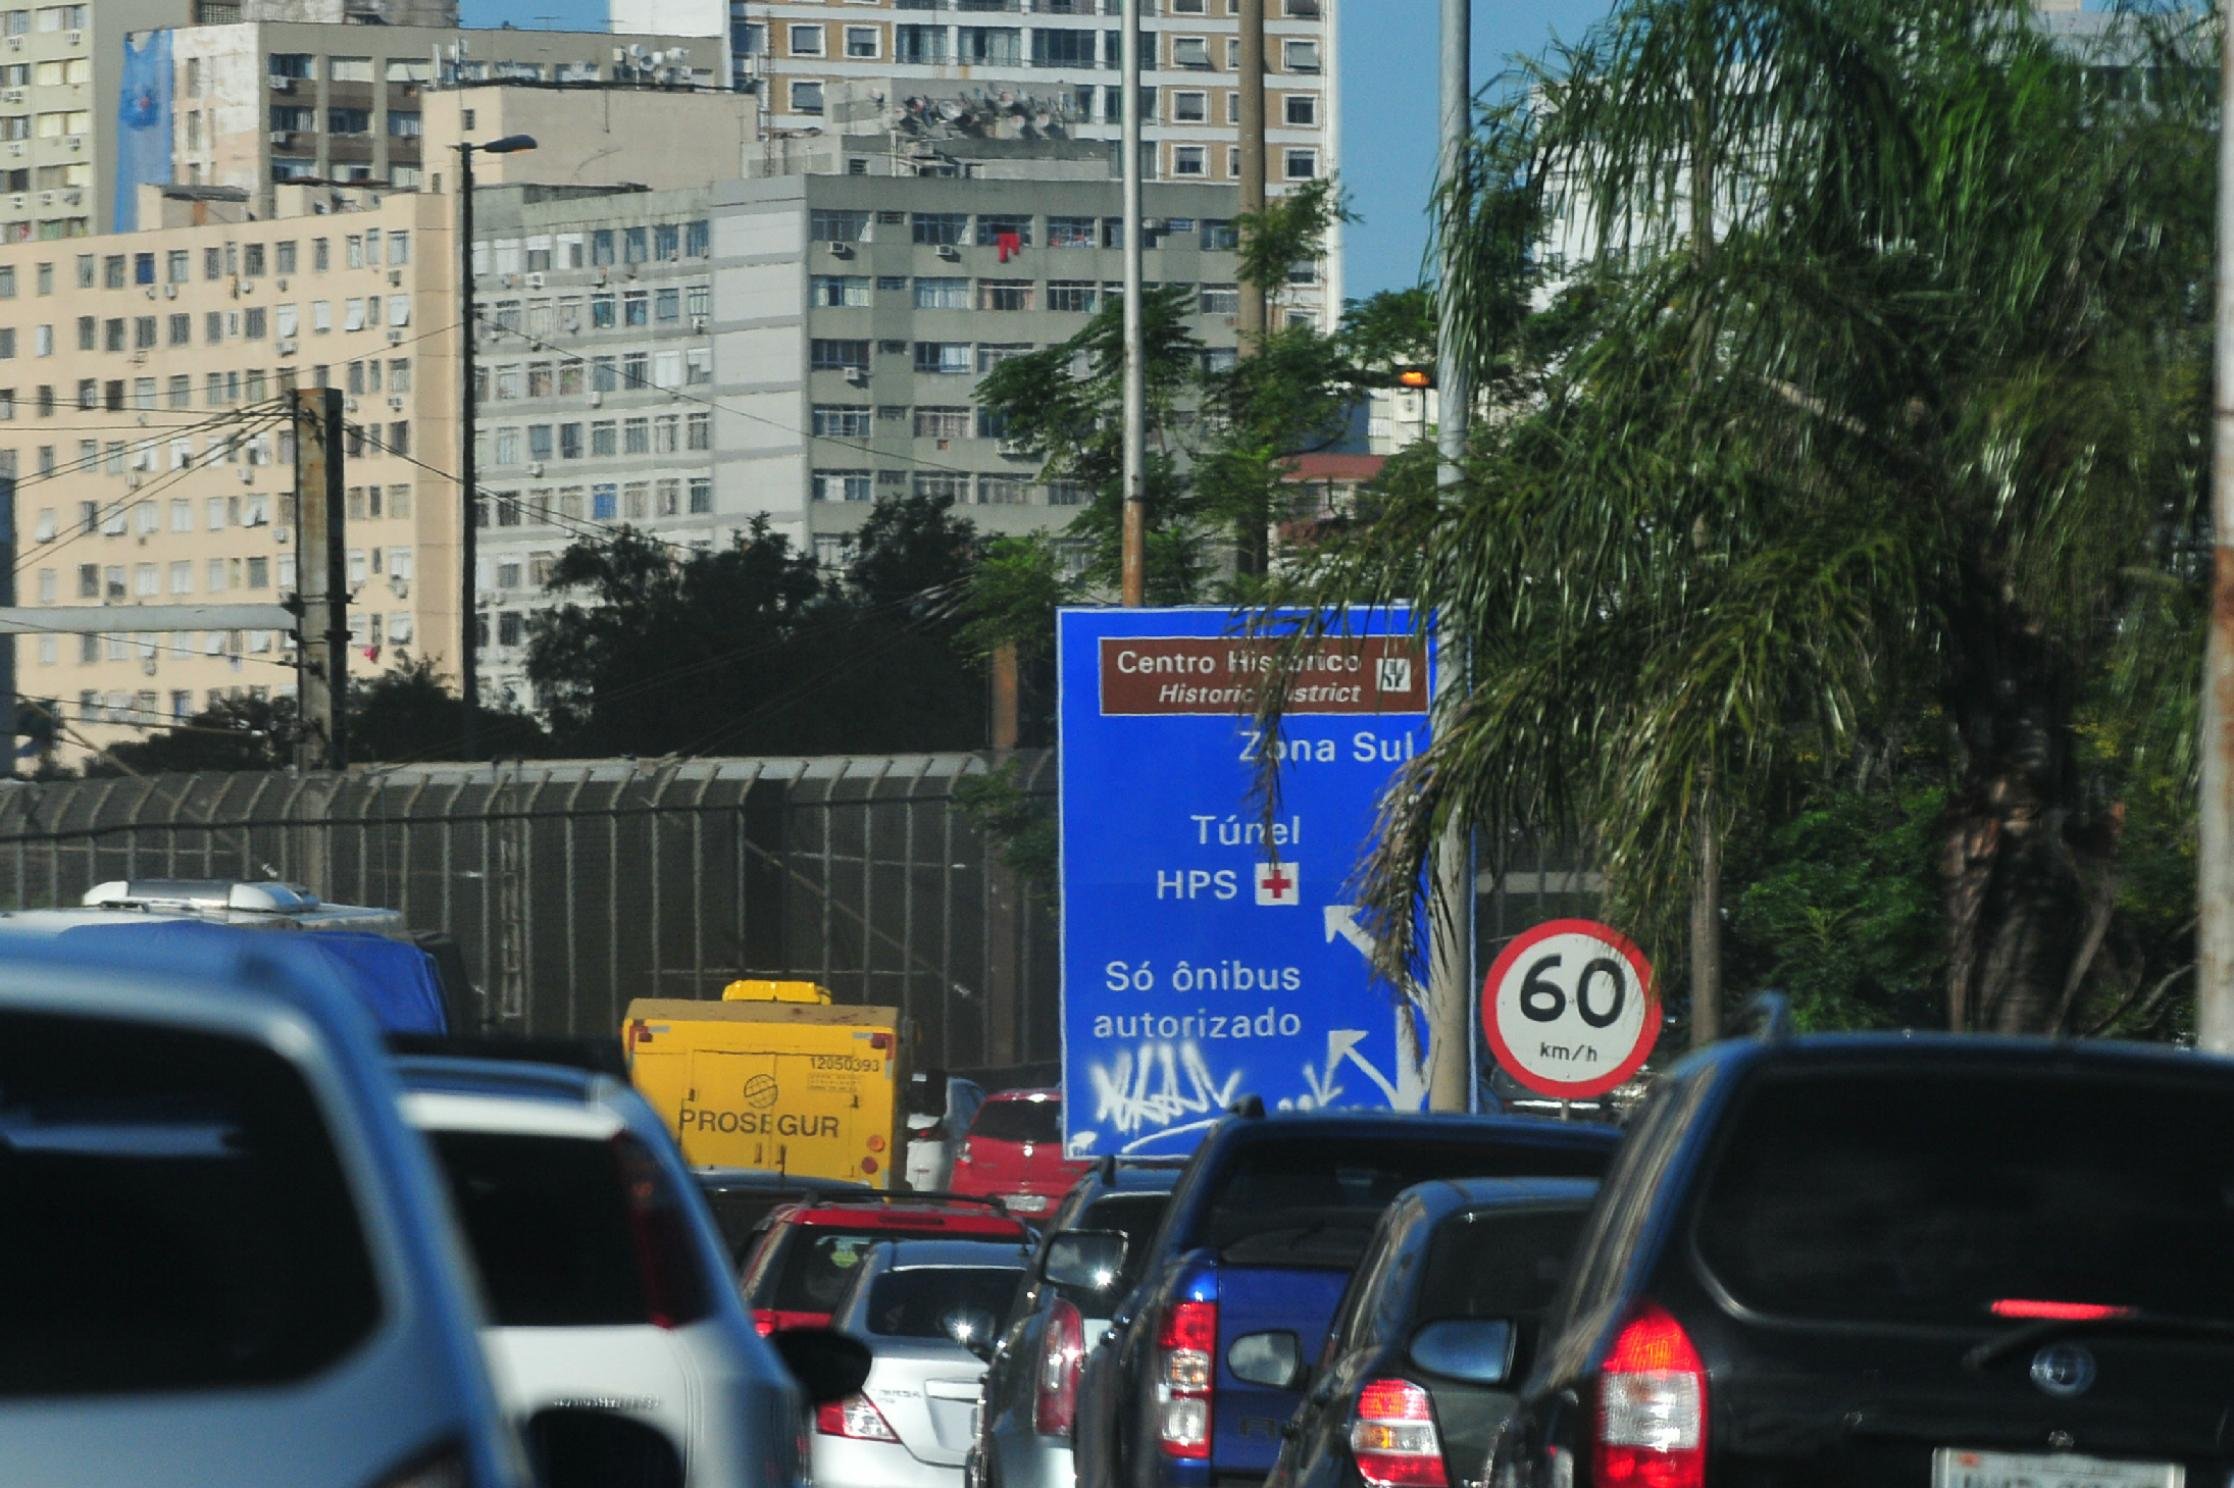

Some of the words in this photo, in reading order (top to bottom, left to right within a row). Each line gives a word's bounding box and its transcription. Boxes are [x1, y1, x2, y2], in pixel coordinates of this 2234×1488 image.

[1117, 650, 1216, 674] Centro
[1227, 650, 1362, 673] Hisrico
[1158, 683, 1256, 703] Historic
[1267, 682, 1362, 703] strict
[1239, 730, 1336, 762] Zona
[1352, 730, 1415, 762] Sul
[1189, 813, 1301, 846] Túnel
[1156, 869, 1238, 900] HPS
[1105, 960, 1155, 992] Só
[1171, 959, 1302, 992] ônibus
[1519, 952, 1627, 1029] 60
[1093, 1006, 1302, 1039] autorizado
[810, 1056, 880, 1073] 12050393
[1539, 1041, 1598, 1062] km/h
[679, 1108, 840, 1138] PROSEGUR
